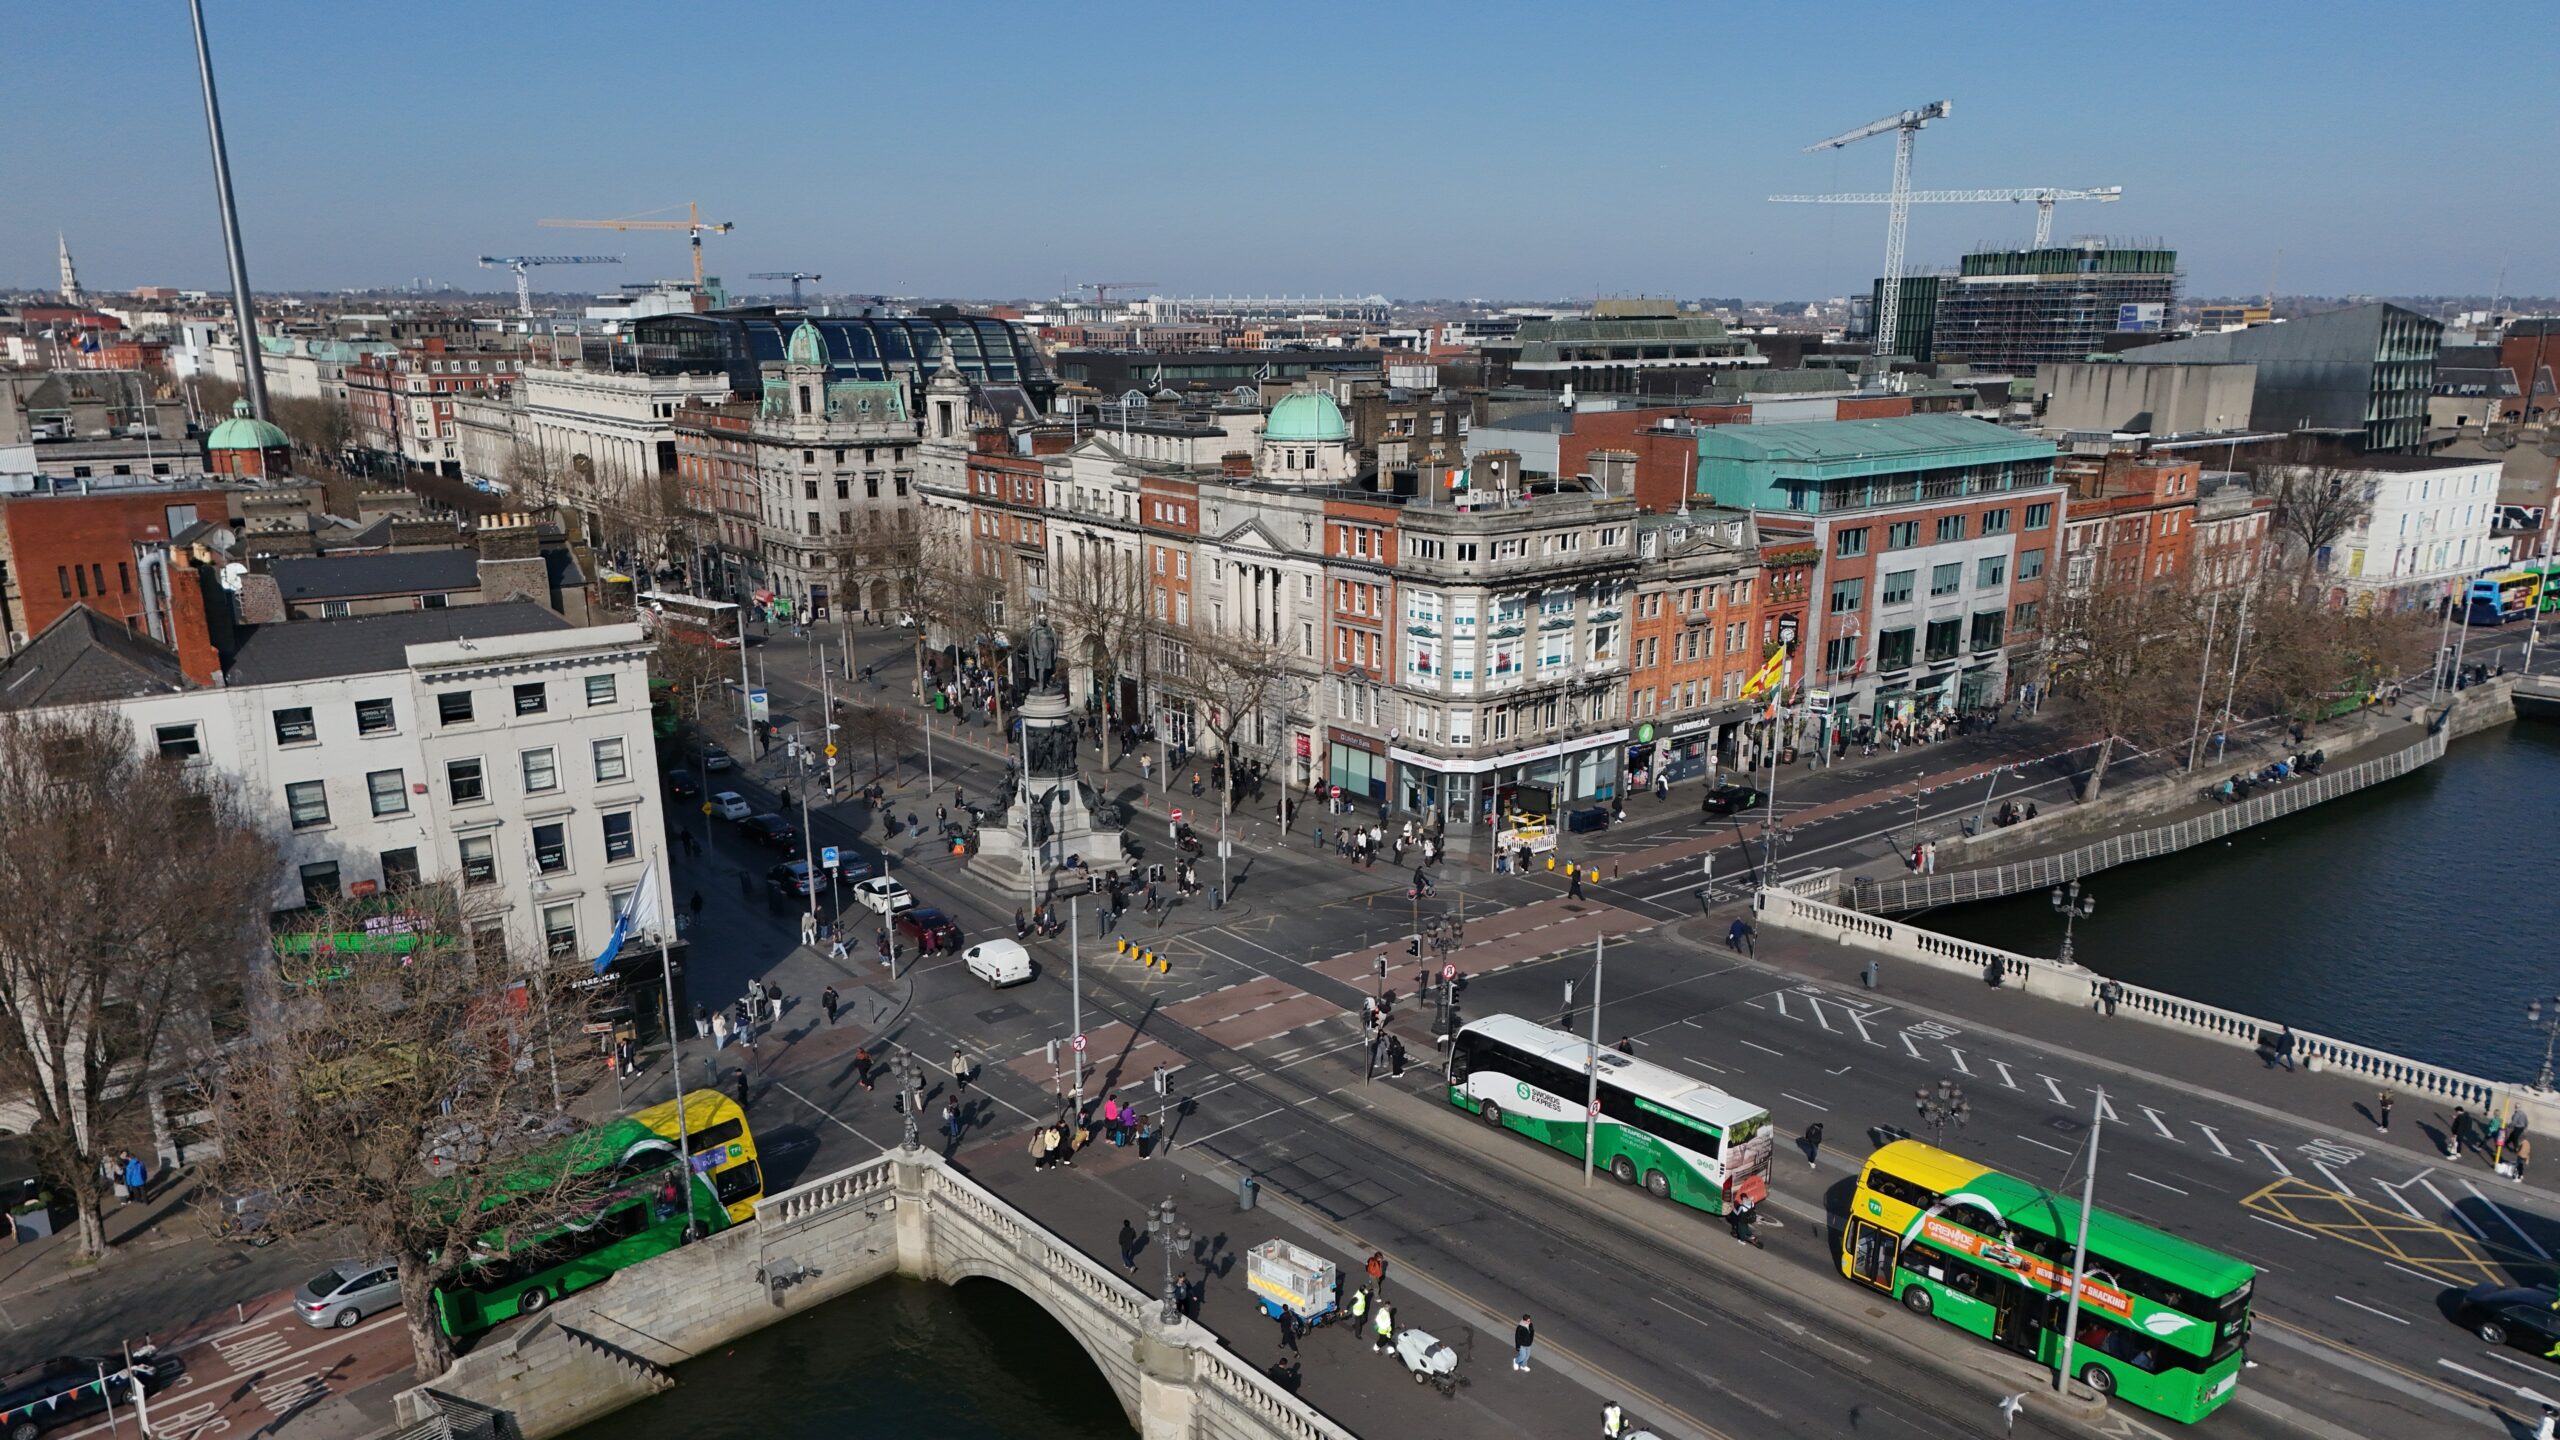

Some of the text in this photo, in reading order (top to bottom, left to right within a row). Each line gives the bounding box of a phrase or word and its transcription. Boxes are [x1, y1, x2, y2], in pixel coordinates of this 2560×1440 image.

[1673, 718, 1710, 733] DAYBREAK
[1532, 1088, 1561, 1106] SWORDS
[1532, 1095, 1562, 1113] EXPRESS
[2036, 1266, 2127, 1311] REVOLUTIONRY SNACKING
